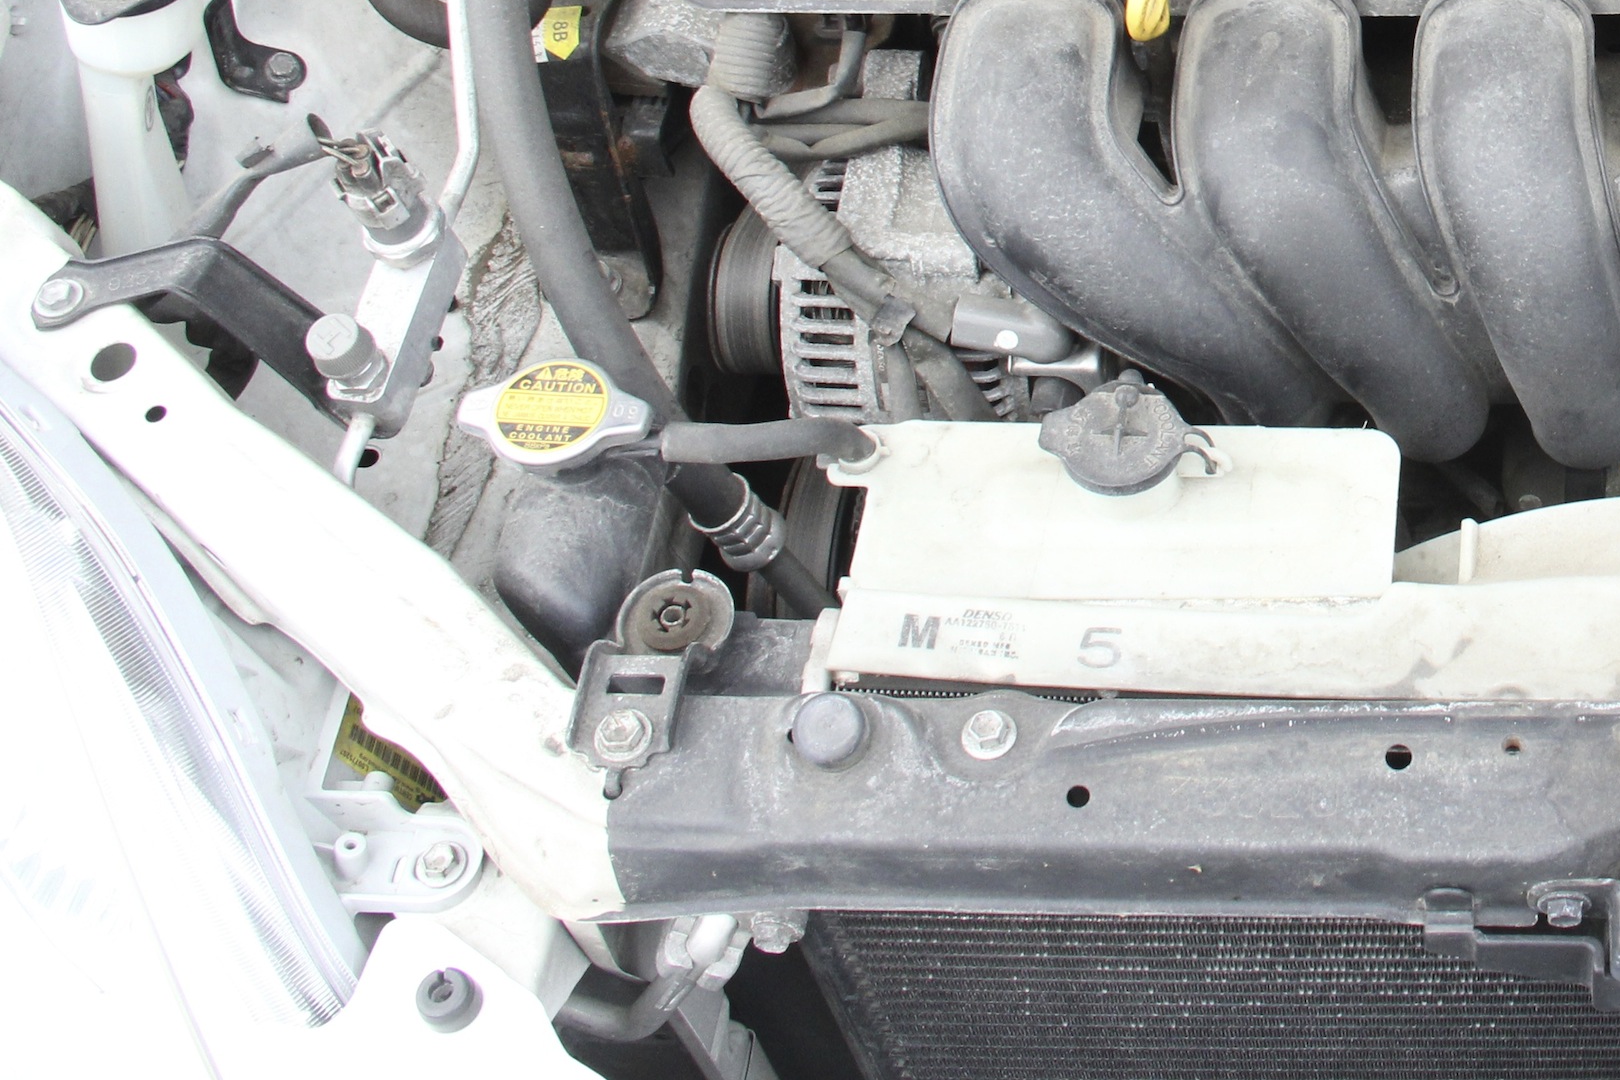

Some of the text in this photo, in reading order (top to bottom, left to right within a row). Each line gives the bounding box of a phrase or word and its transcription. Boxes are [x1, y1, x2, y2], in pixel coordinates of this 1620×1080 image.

[552, 21, 570, 43] 8B
[519, 379, 597, 394] CAUTION
[509, 431, 572, 442] COOLANT
[516, 424, 570, 434] ENGINE
[1143, 403, 1179, 470] COOLANT
[962, 609, 1013, 621] DENSO
[897, 612, 942, 650] M
[1076, 626, 1123, 670] 5
